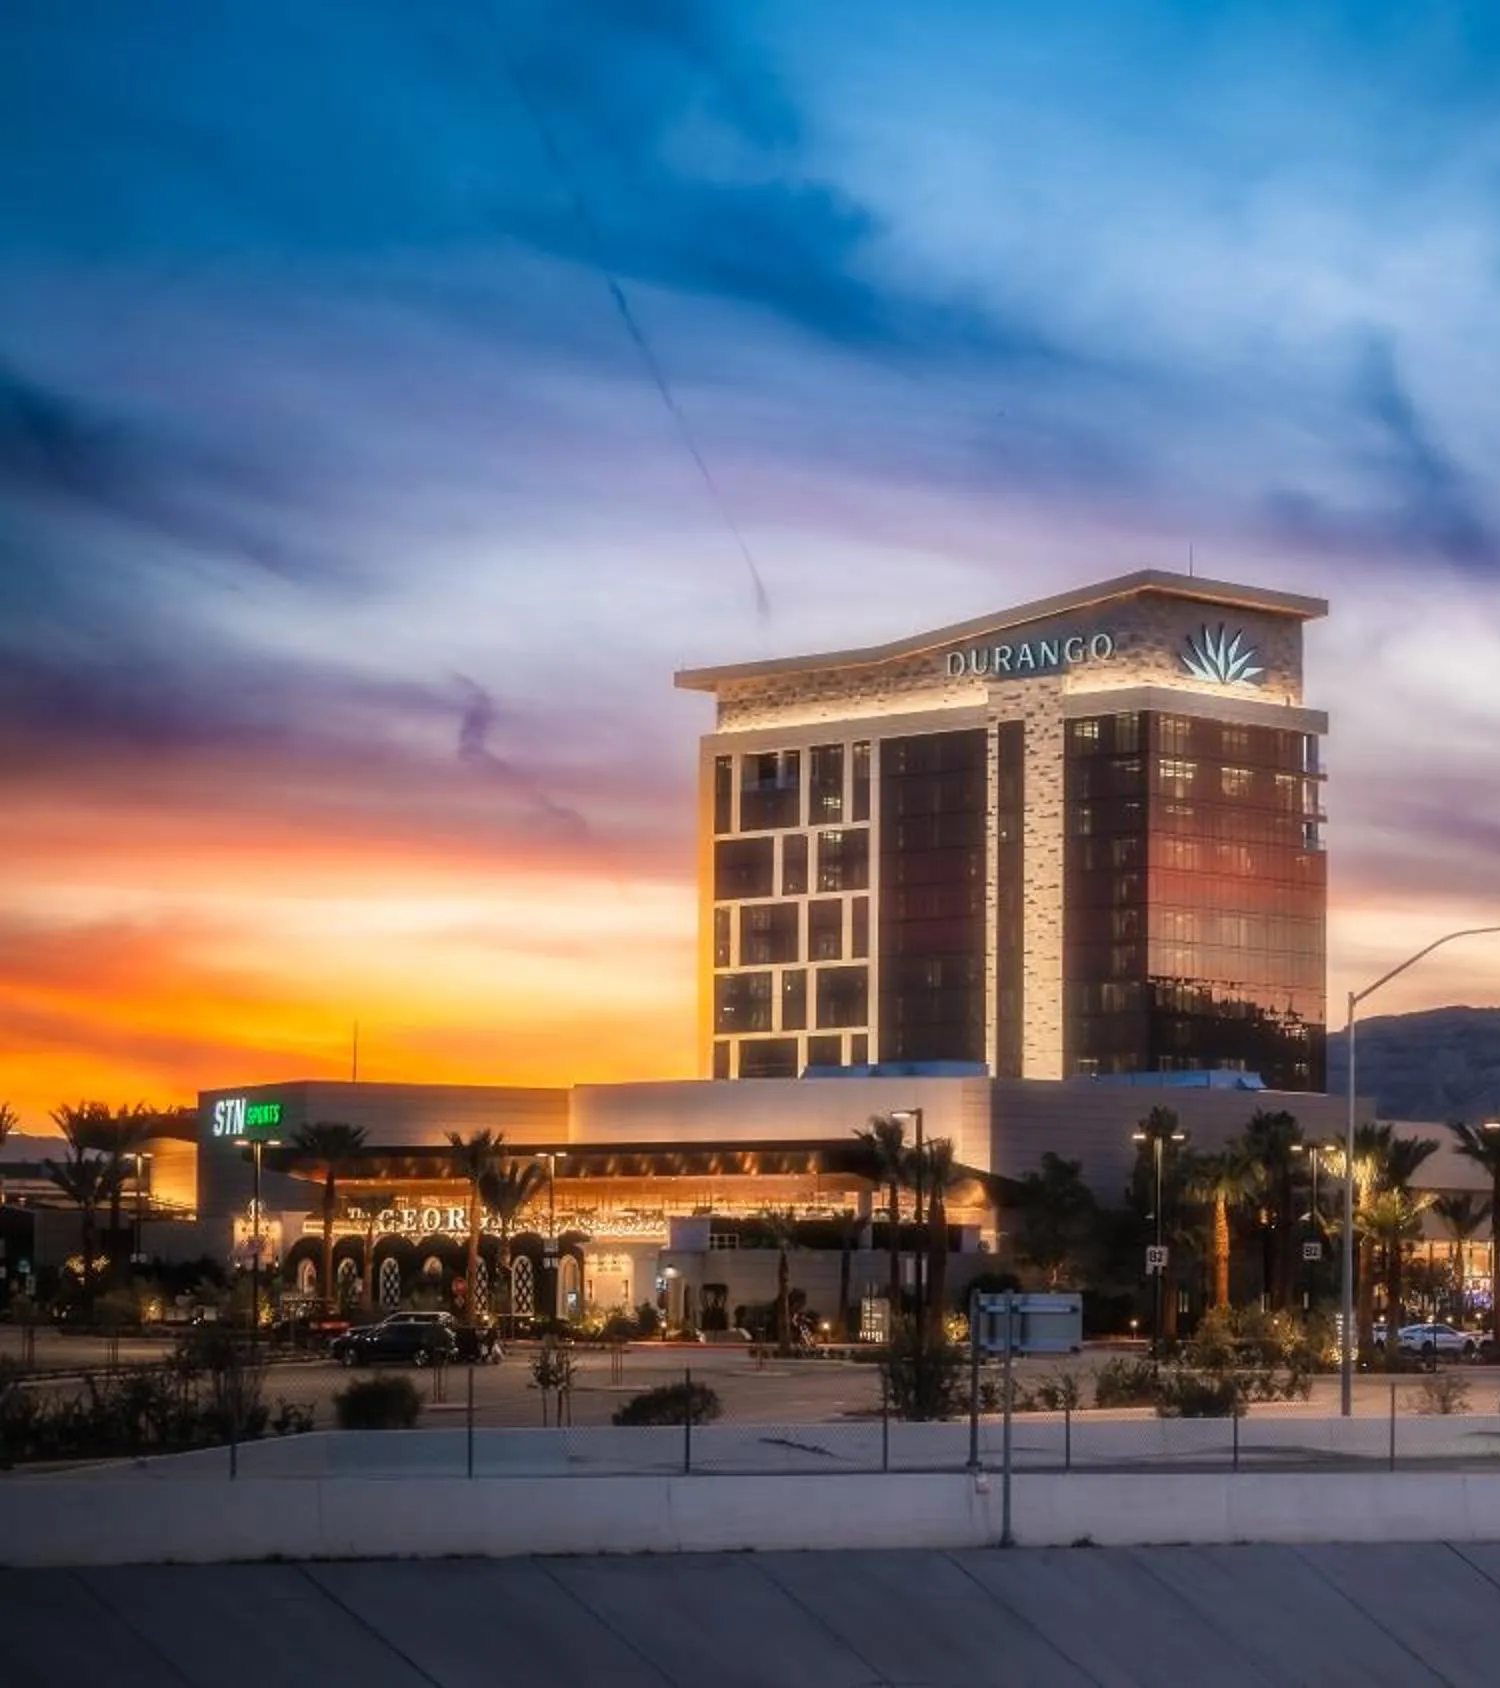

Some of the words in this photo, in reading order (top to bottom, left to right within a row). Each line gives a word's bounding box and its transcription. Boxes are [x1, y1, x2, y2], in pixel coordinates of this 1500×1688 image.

[945, 632, 1114, 677] DURANGO
[213, 1097, 247, 1137] STN
[246, 1103, 281, 1125] SPORTS
